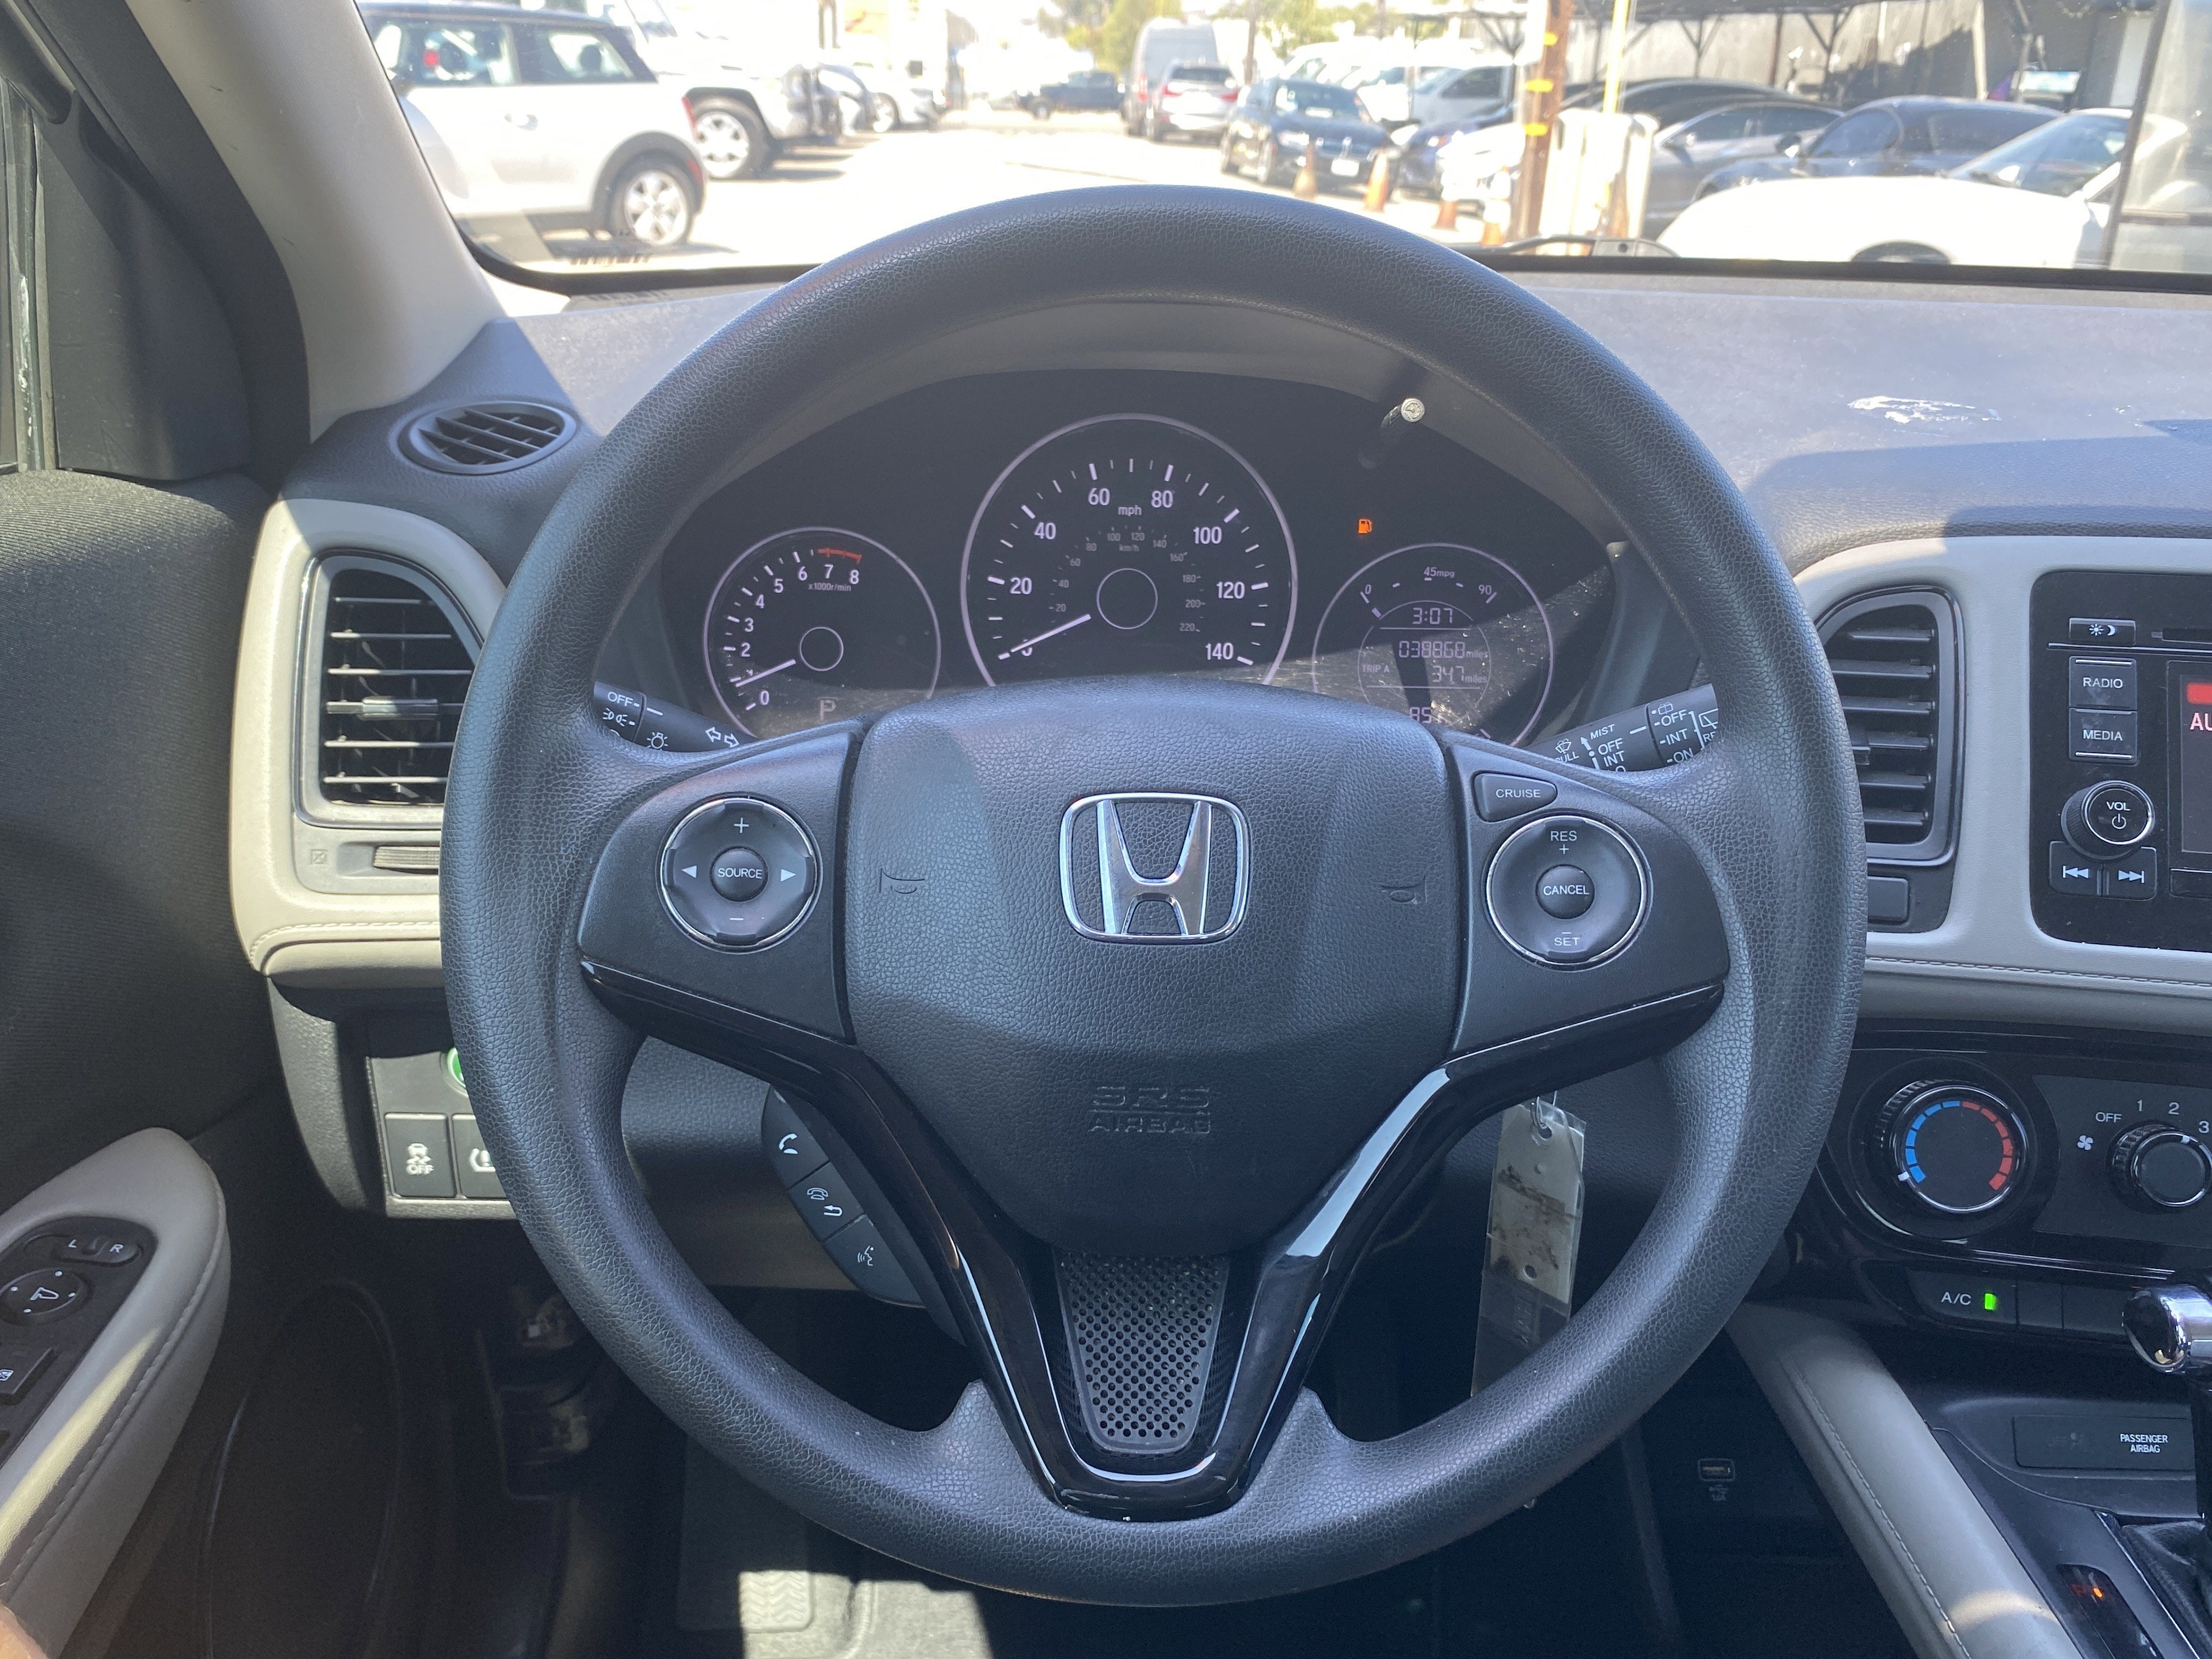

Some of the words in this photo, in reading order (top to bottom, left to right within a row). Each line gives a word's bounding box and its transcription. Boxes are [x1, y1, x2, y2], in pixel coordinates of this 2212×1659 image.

[1088, 488, 1110, 505] 60
[1151, 490, 1173, 508] 80
[1118, 505, 1142, 516] mph
[1034, 522, 1056, 540] 40
[1107, 533, 1121, 541] 100
[1131, 532, 1145, 541] 120
[1193, 527, 1222, 544] 100
[1086, 543, 1097, 551] 80
[1153, 539, 1167, 548] 140
[1070, 558, 1081, 567] 60
[1170, 553, 1184, 562] 160
[798, 566, 808, 580] 6
[825, 564, 833, 579] 7
[850, 569, 859, 584] 8
[1059, 579, 1069, 588] 40
[1183, 574, 1197, 583] 180
[774, 579, 783, 593] 5
[1010, 577, 1032, 594] 20
[1216, 582, 1245, 599] 120
[1365, 584, 1372, 595] 0
[1479, 584, 1492, 595] 90
[755, 595, 764, 608] 4
[1056, 603, 1066, 612] 20
[1186, 600, 1201, 608] 200
[1412, 607, 1453, 624] 3:07
[745, 618, 754, 632] 3
[1180, 623, 1195, 631] 220
[741, 642, 751, 657] 2
[1205, 642, 1234, 660] 140
[1466, 650, 1488, 658] miles
[1362, 664, 1381, 673] TRIP
[1383, 664, 1390, 673] A
[1465, 674, 1487, 684] miles
[2083, 677, 2123, 689] RADIO
[607, 692, 633, 706] OFF
[760, 690, 769, 706] 0
[820, 699, 836, 721] P
[1661, 709, 1687, 726] OFF
[1590, 724, 1615, 740] MIST
[1666, 729, 1688, 746] INT
[2083, 730, 2123, 741] MEDIA
[1598, 738, 1623, 755] OFF
[1603, 750, 1624, 767] INT
[1673, 747, 1694, 763] ON
[1496, 789, 1541, 798] CRUISE
[2106, 802, 2131, 811] VOL
[1550, 831, 1577, 841] RES
[718, 868, 763, 879] SOURCE
[1543, 885, 1590, 895] CANCEL
[1554, 936, 1580, 946] SET
[2137, 1099, 2143, 1111] 1
[2168, 1102, 2180, 1115] 2
[2095, 1112, 2122, 1124] OFF
[2198, 1120, 2210, 1133] 3
[406, 1164, 434, 1175] OFF
[69, 1239, 78, 1248] L
[110, 1244, 123, 1253] R
[1941, 1291, 1972, 1305] A/C
[2120, 1434, 2169, 1443] PASSENGER
[2130, 1444, 2161, 1453] AIRBAG
